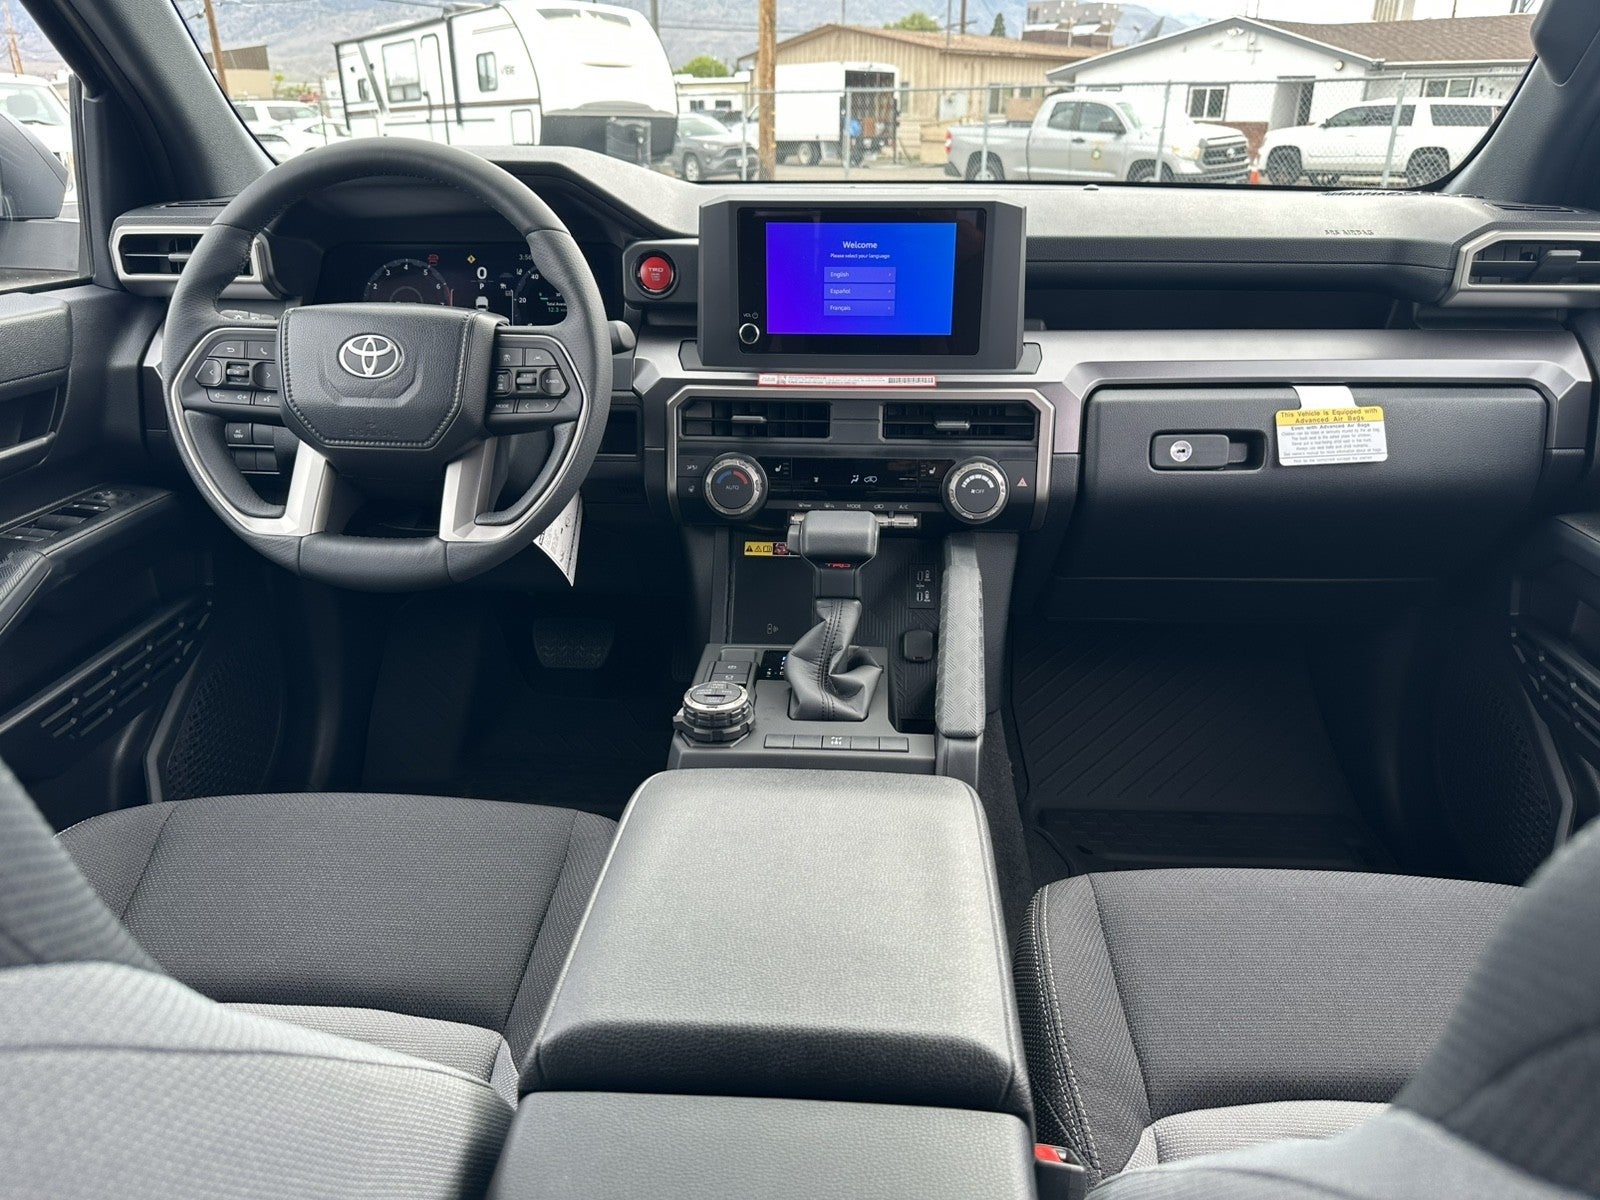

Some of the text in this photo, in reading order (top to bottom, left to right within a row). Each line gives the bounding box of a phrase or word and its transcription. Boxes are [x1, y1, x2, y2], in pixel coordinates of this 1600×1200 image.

[842, 240, 878, 249] Welcome
[869, 252, 890, 260] language
[476, 266, 488, 280] 0
[830, 271, 850, 279] English
[830, 287, 851, 295] Español
[830, 304, 851, 312] Français
